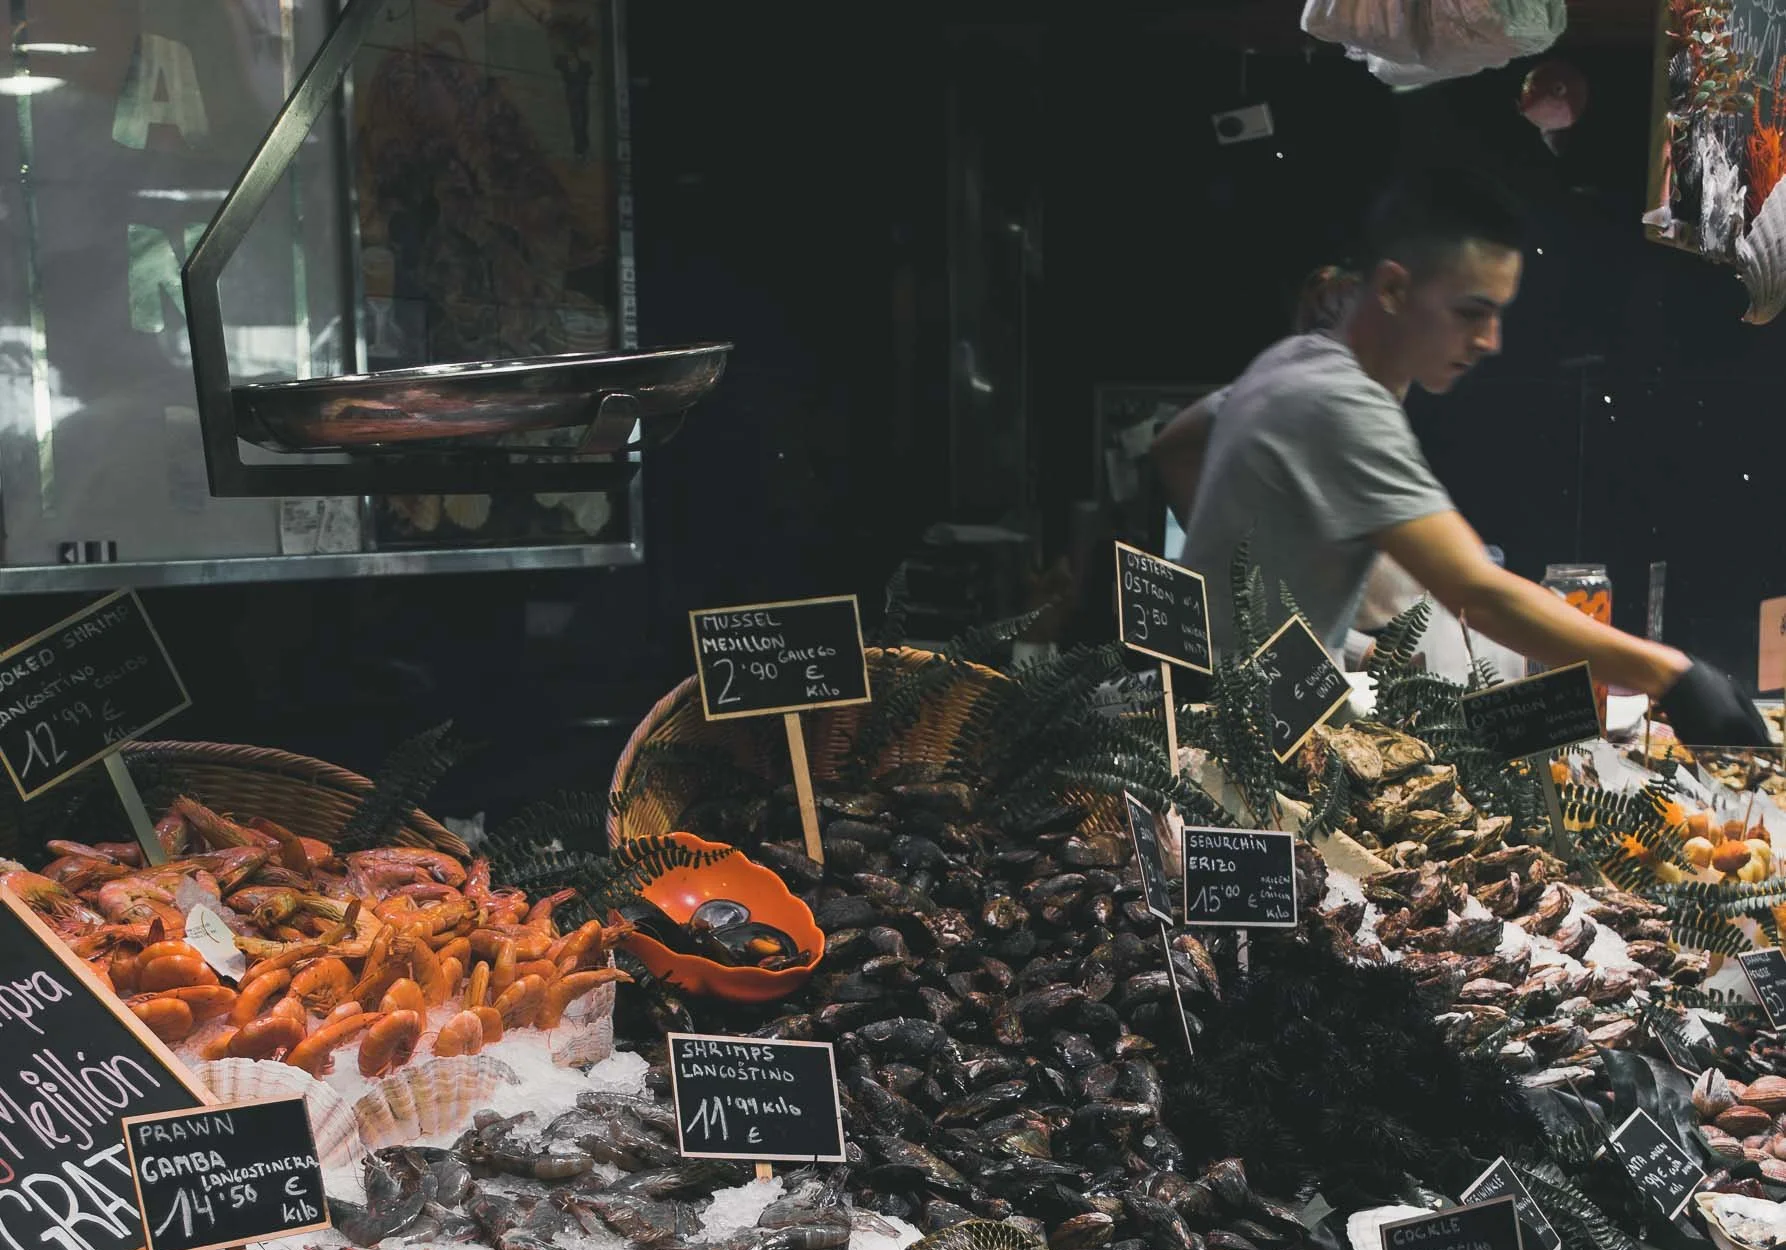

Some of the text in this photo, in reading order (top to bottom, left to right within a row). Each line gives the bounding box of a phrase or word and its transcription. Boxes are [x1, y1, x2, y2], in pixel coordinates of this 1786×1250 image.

[704, 612, 782, 632] MUSSEL
[0, 664, 95, 730] ANGOSTINO
[1189, 855, 1236, 873] ERIZO
[681, 1042, 777, 1063] SHRIMPS
[138, 1112, 236, 1147] PRAWN
[141, 1150, 228, 1184] GAMBA
